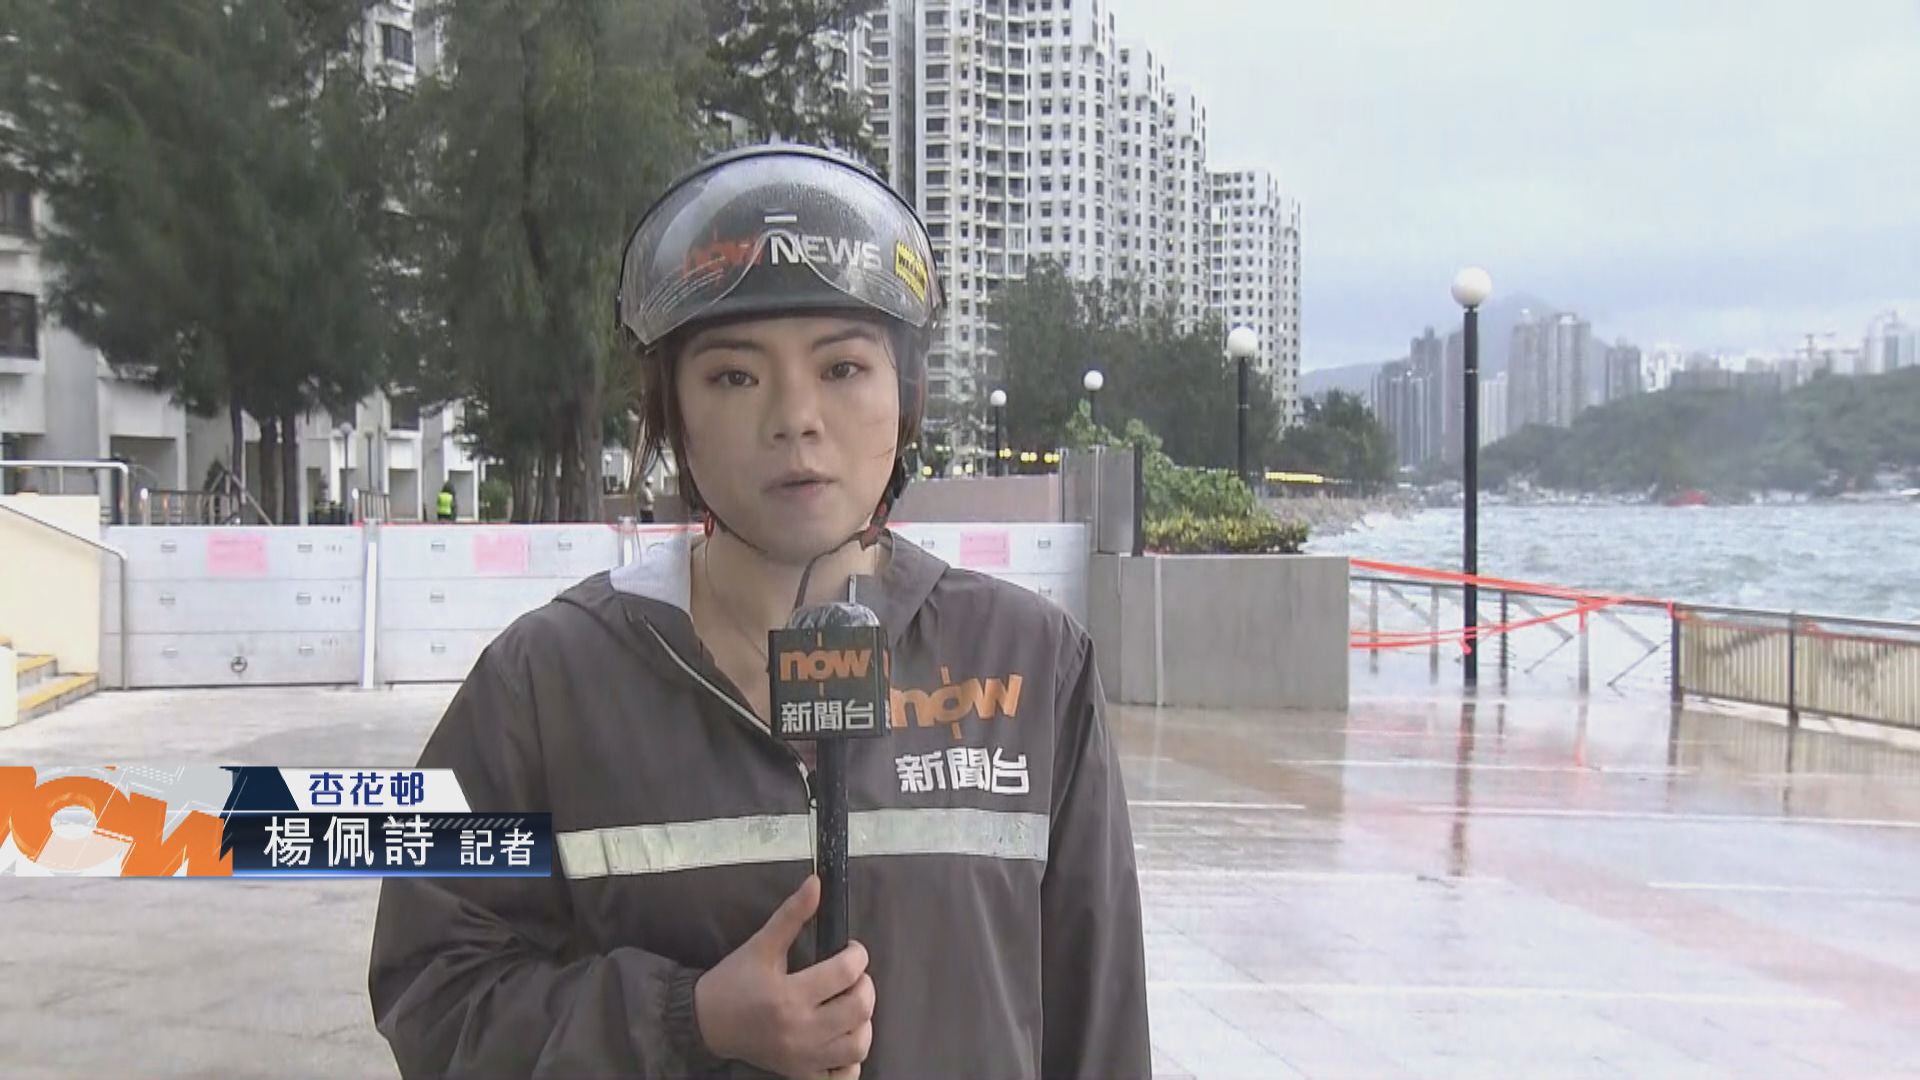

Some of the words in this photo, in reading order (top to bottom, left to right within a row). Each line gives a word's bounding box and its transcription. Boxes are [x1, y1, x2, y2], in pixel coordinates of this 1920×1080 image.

[771, 234, 882, 269] NEWS
[780, 649, 872, 681] now
[781, 699, 874, 733] 新聞台
[890, 673, 1023, 728] now
[895, 747, 1030, 795] 新聞台
